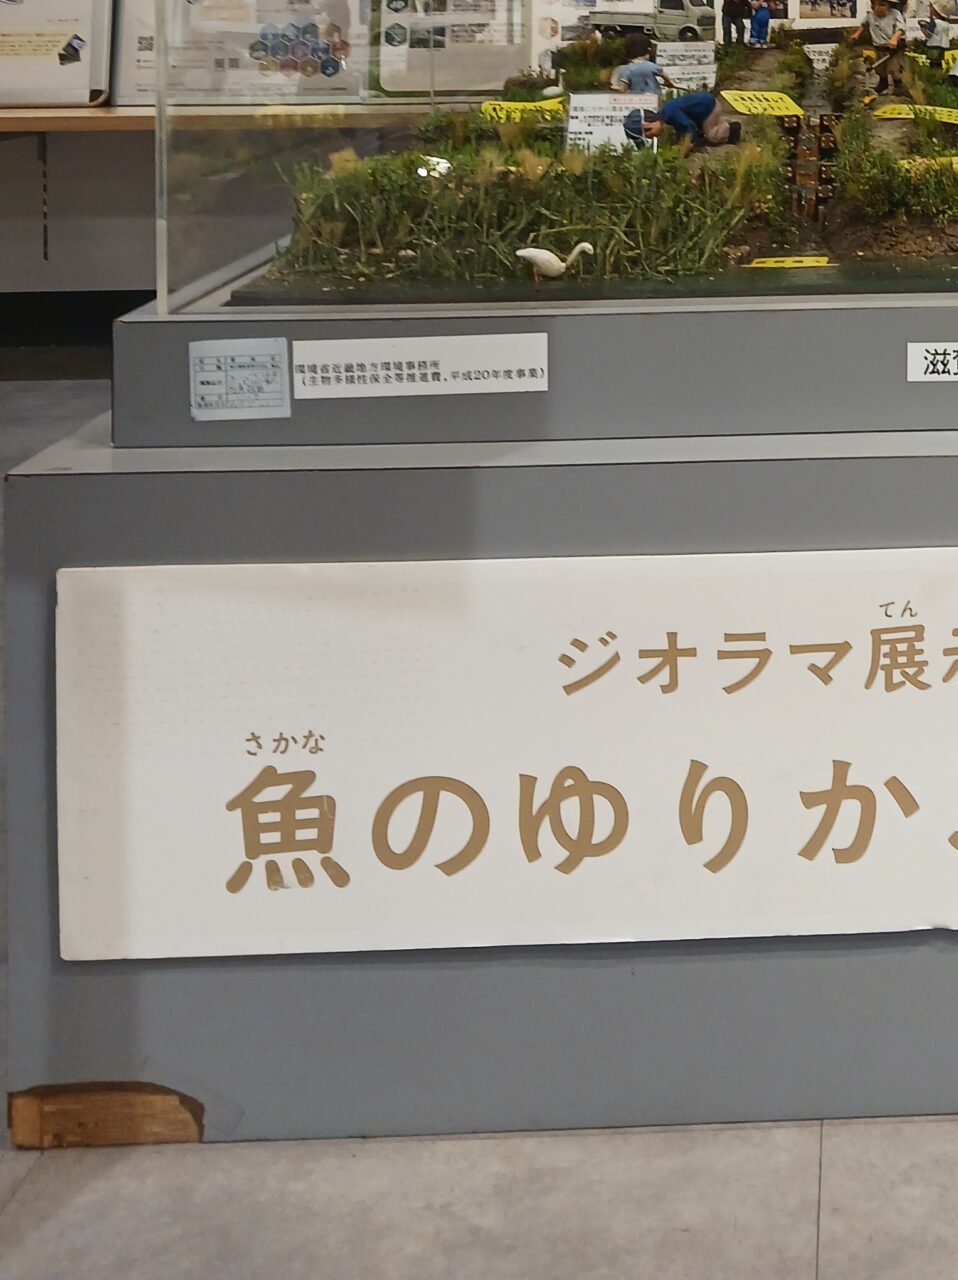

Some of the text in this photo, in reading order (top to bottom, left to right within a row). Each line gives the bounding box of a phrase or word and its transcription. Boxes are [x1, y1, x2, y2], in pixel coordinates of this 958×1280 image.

[877, 599, 921, 620] てん
[242, 728, 327, 757] さかな
